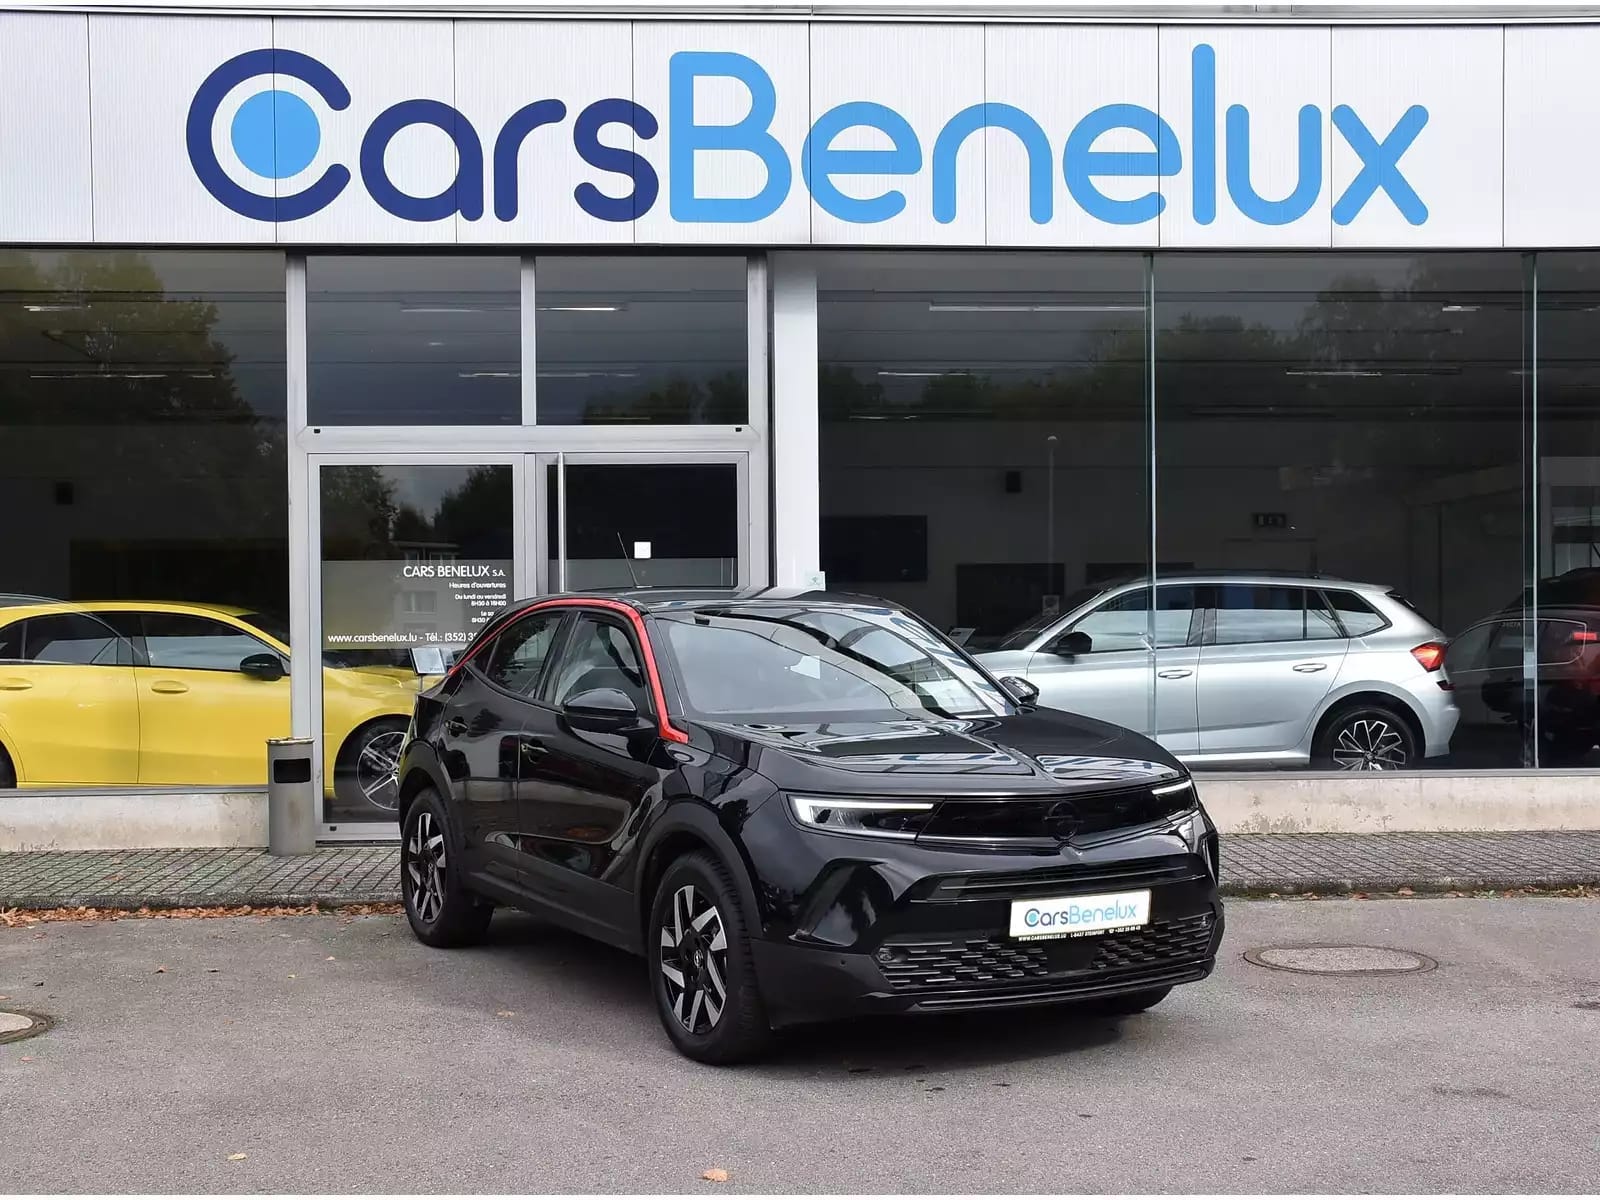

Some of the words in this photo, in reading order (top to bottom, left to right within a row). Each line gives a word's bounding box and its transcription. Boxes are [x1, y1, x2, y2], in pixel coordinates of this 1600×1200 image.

[186, 43, 1429, 226] CarsBenelux
[403, 565, 434, 577] CARS
[437, 565, 490, 577] BENELUX
[328, 632, 418, 643] www.carsbenelux.lu
[444, 632, 467, 643] (352)
[1024, 899, 1137, 928] CarsBenelux
